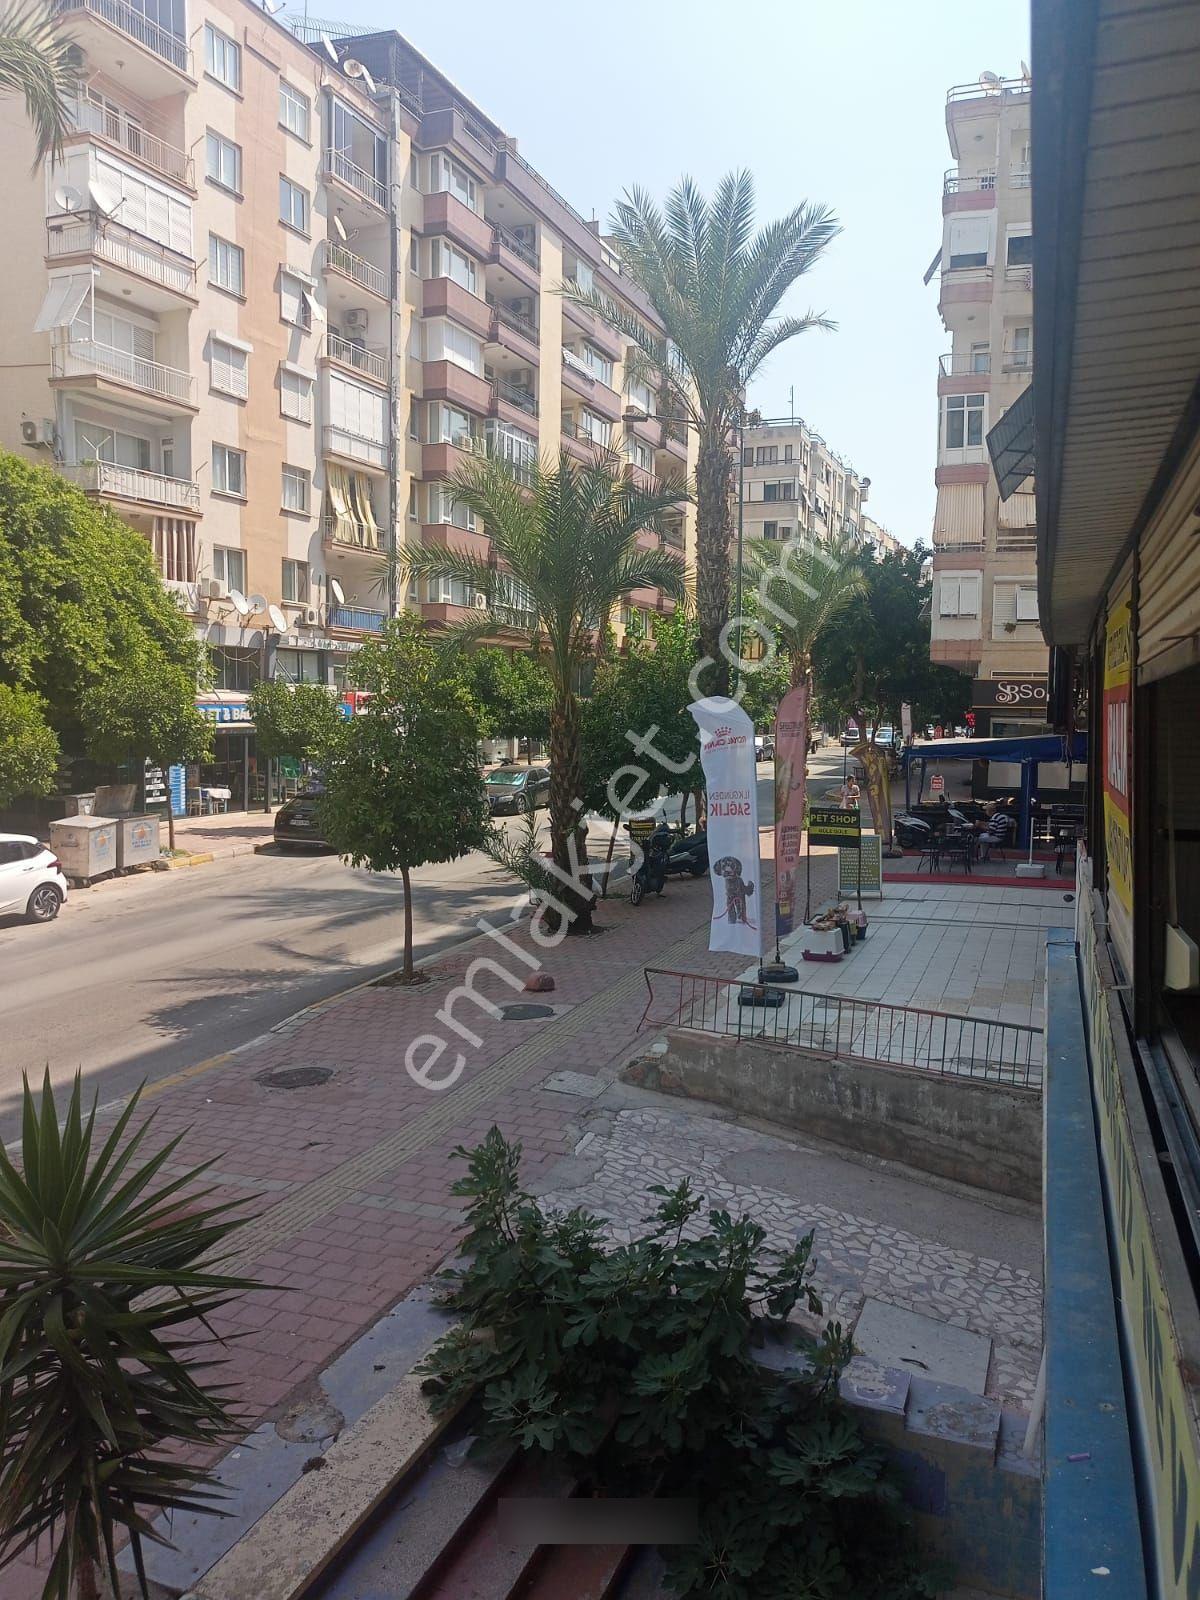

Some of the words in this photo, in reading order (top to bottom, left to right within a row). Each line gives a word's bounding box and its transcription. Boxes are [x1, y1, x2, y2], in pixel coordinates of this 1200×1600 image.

[1019, 684, 1049, 702] So
[810, 814, 828, 822] PET
[830, 815, 857, 824] SHOP
